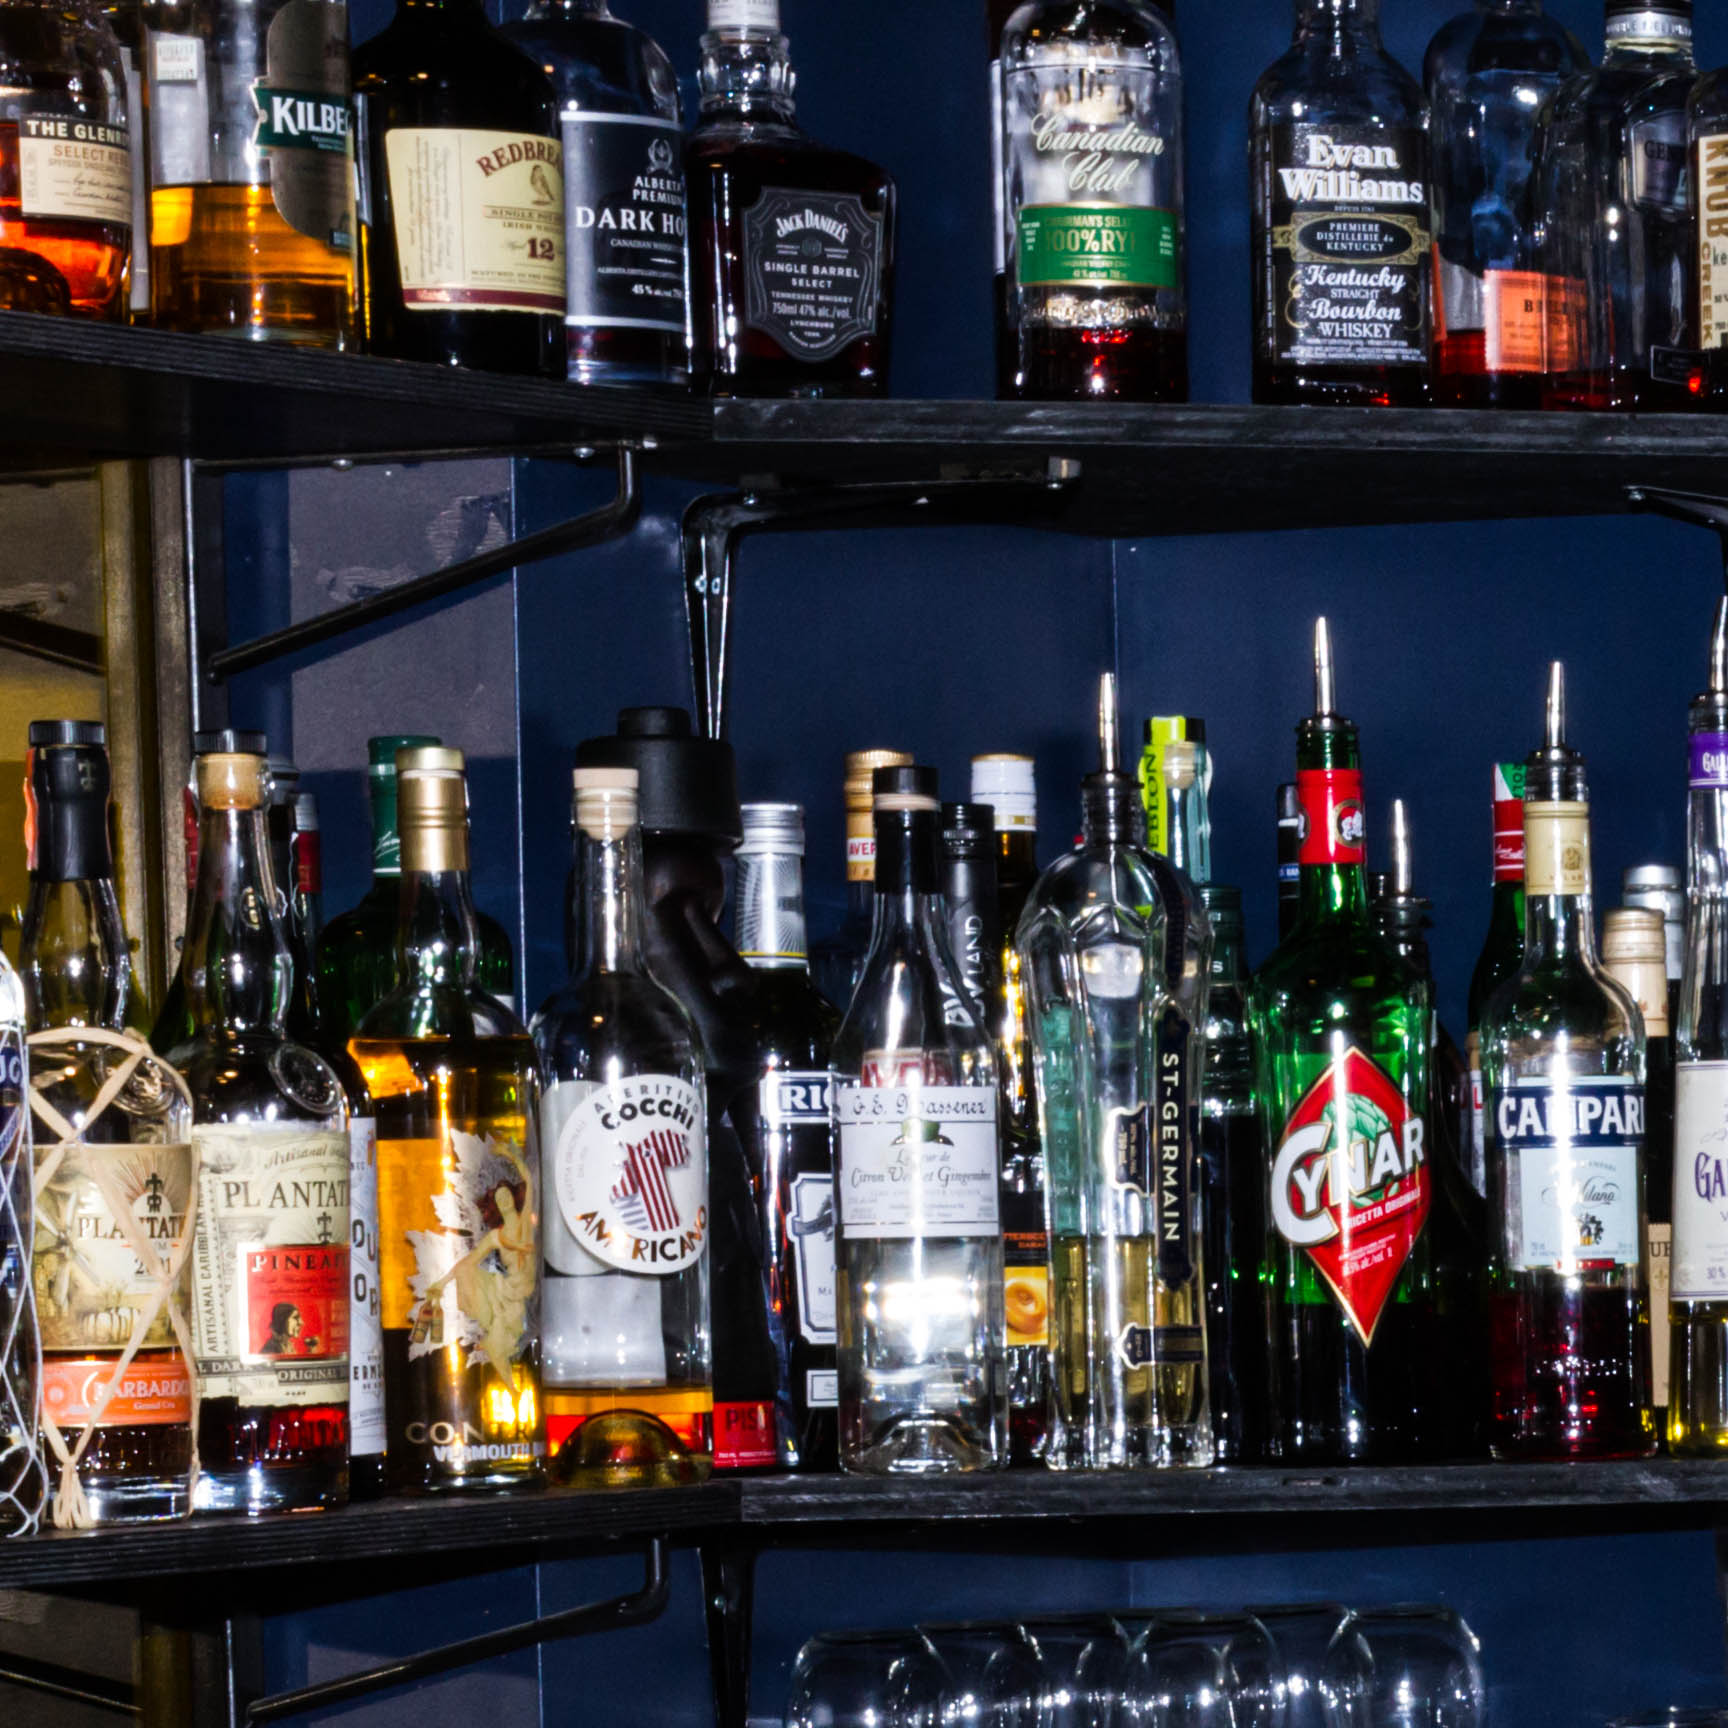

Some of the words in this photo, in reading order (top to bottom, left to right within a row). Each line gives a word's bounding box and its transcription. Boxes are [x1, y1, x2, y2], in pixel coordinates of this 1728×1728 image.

[27, 119, 68, 138] THE
[1031, 112, 1165, 156] Canadian
[53, 144, 104, 162] SELECT
[1305, 134, 1400, 170] Evan
[1062, 152, 1140, 192] Club
[1278, 167, 1425, 204] Williams
[575, 206, 656, 232] DARK
[661, 211, 684, 236] HO
[776, 214, 804, 238] JACK
[804, 208, 849, 244] DANIEL'S
[1330, 222, 1380, 233] PREMIERE
[1316, 231, 1380, 243] DISTILLERIE
[1326, 242, 1385, 252] KENTUCKY
[526, 238, 556, 261] 12
[764, 261, 807, 275] SINGLE
[812, 264, 860, 278] BARREL
[1304, 264, 1406, 295] Kentucky
[791, 277, 833, 289] SELECT
[1330, 288, 1381, 300] STRAIGHT
[1701, 241, 1713, 341] CREEK
[771, 290, 816, 301] TENNESSEE
[1308, 299, 1403, 322] Bourbon
[1318, 321, 1394, 339] WHISKEY
[600, 1098, 695, 1131] COCCHI
[1162, 1052, 1180, 1242] ST-GERMAIN
[1271, 1117, 1425, 1247] CYNAR
[1584, 1184, 1616, 1203] ilano
[562, 1204, 708, 1263] AMRICANO
[203, 1276, 218, 1352] ARTISANAL
[277, 1366, 339, 1383] ORIGINAL
